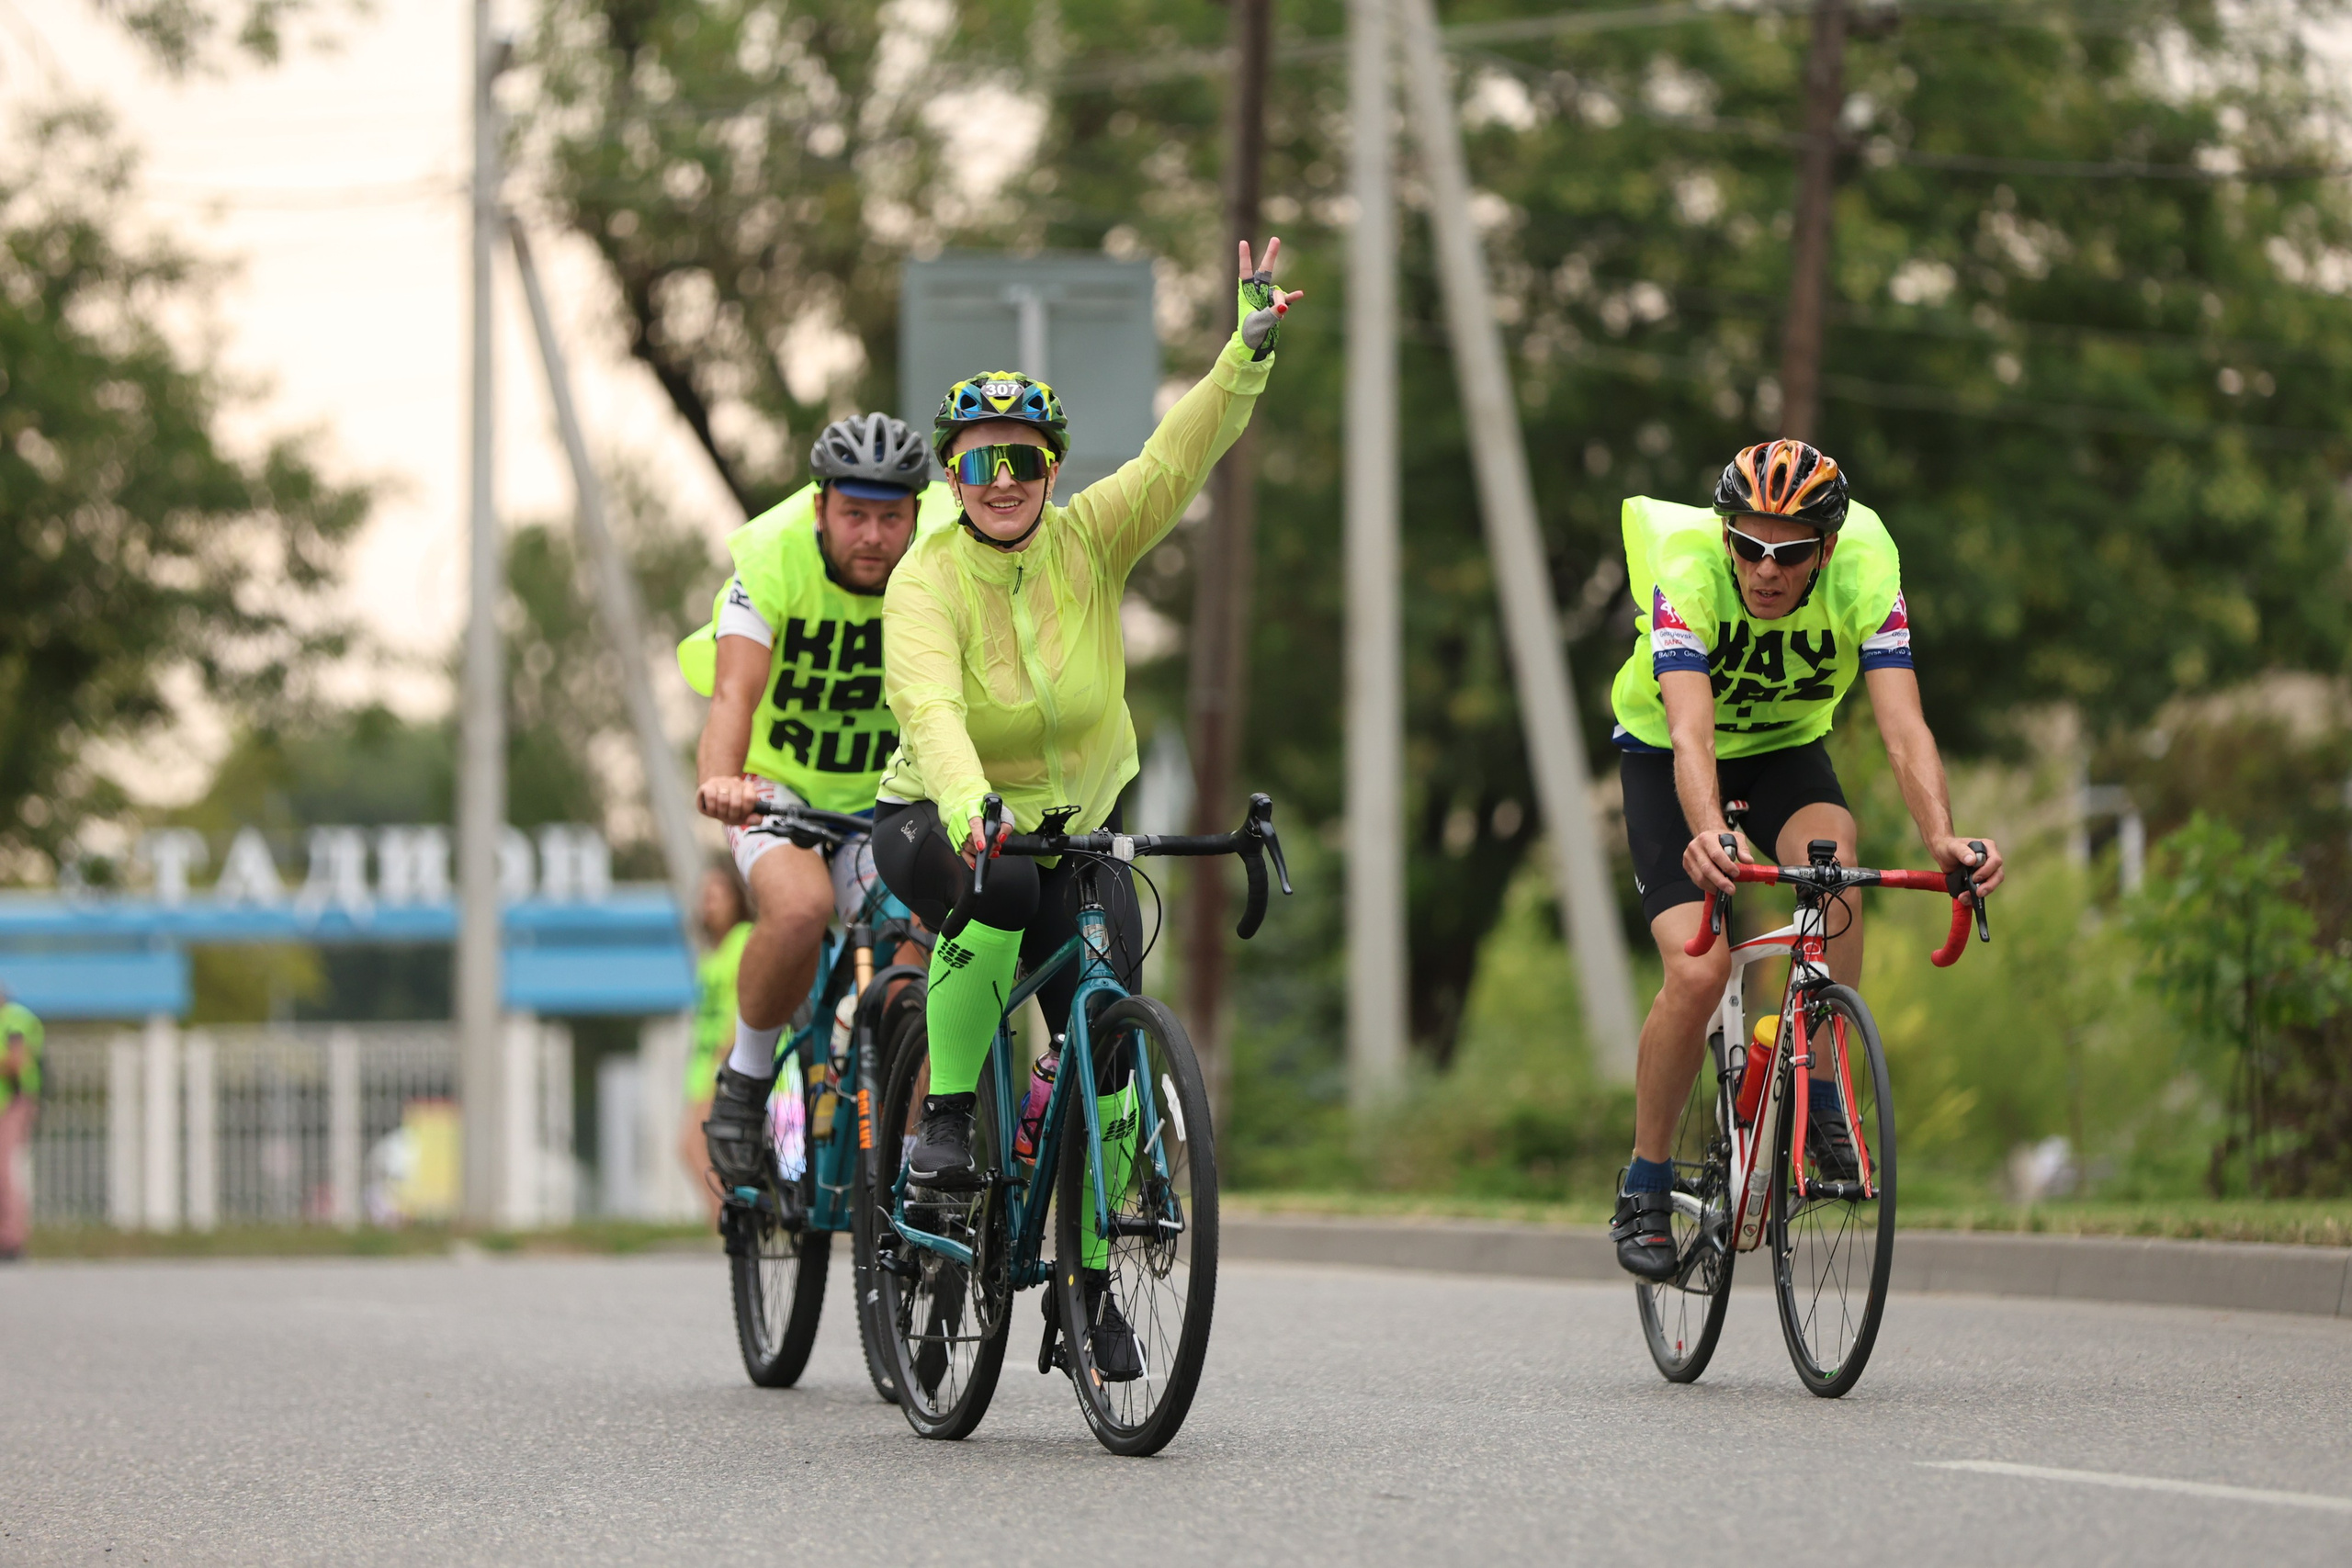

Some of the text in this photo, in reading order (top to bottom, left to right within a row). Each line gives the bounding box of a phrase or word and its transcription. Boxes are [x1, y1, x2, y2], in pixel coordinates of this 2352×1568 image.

[985, 384, 1019, 395] 307
[784, 617, 883, 672] KA
[772, 669, 896, 713] KA
